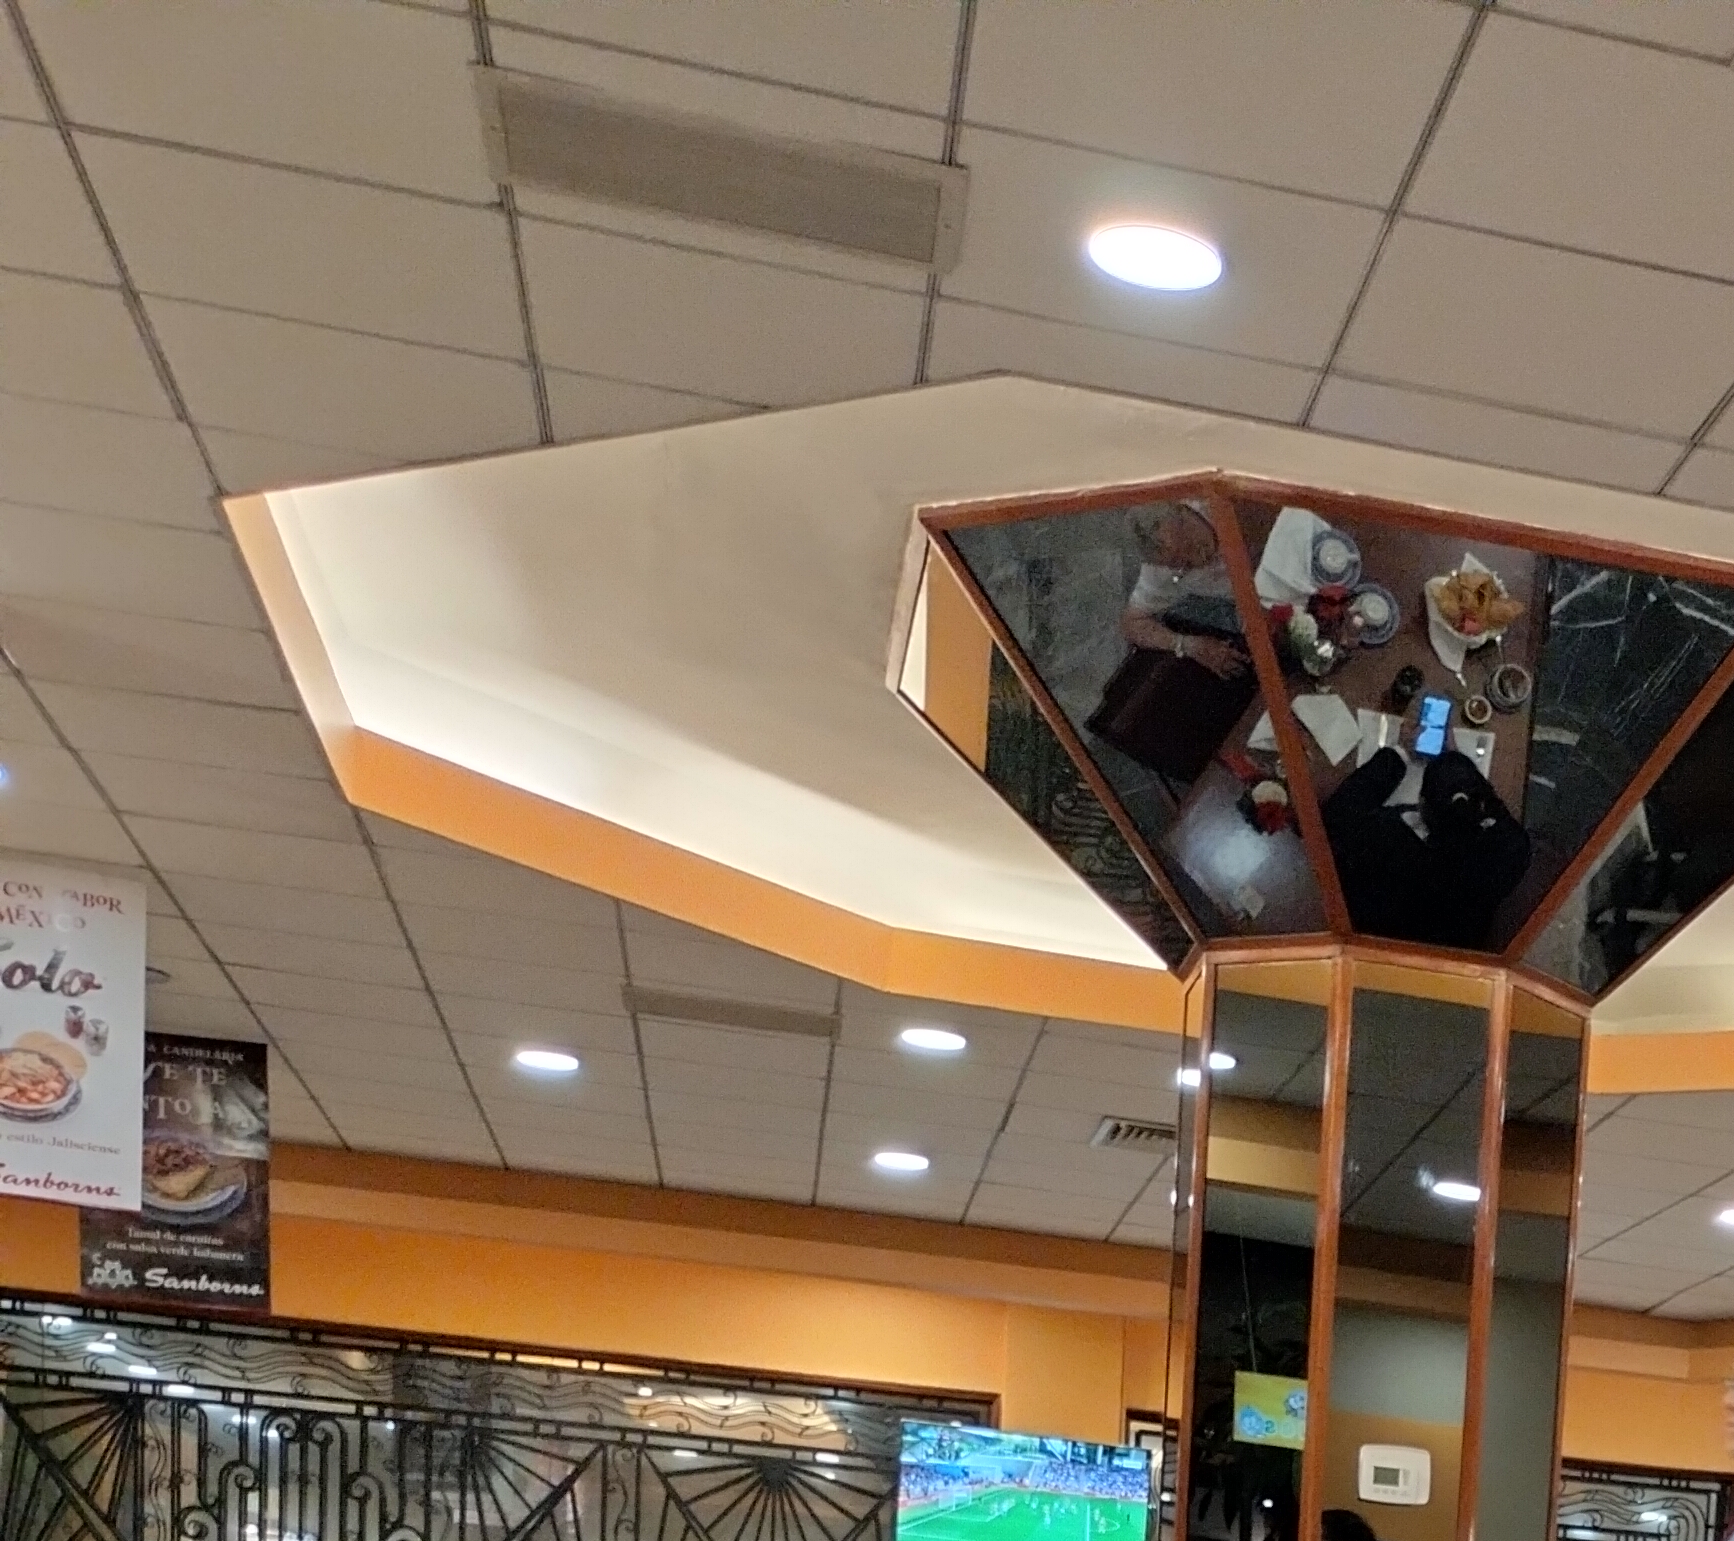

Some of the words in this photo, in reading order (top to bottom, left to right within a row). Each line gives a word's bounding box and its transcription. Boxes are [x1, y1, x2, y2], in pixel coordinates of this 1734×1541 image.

[3, 881, 43, 899] CON
[0, 940, 103, 997] olo
[47, 1136, 121, 1156] Jalisciense
[0, 1163, 121, 1197] anborns
[144, 1267, 265, 1297] Sanborns
